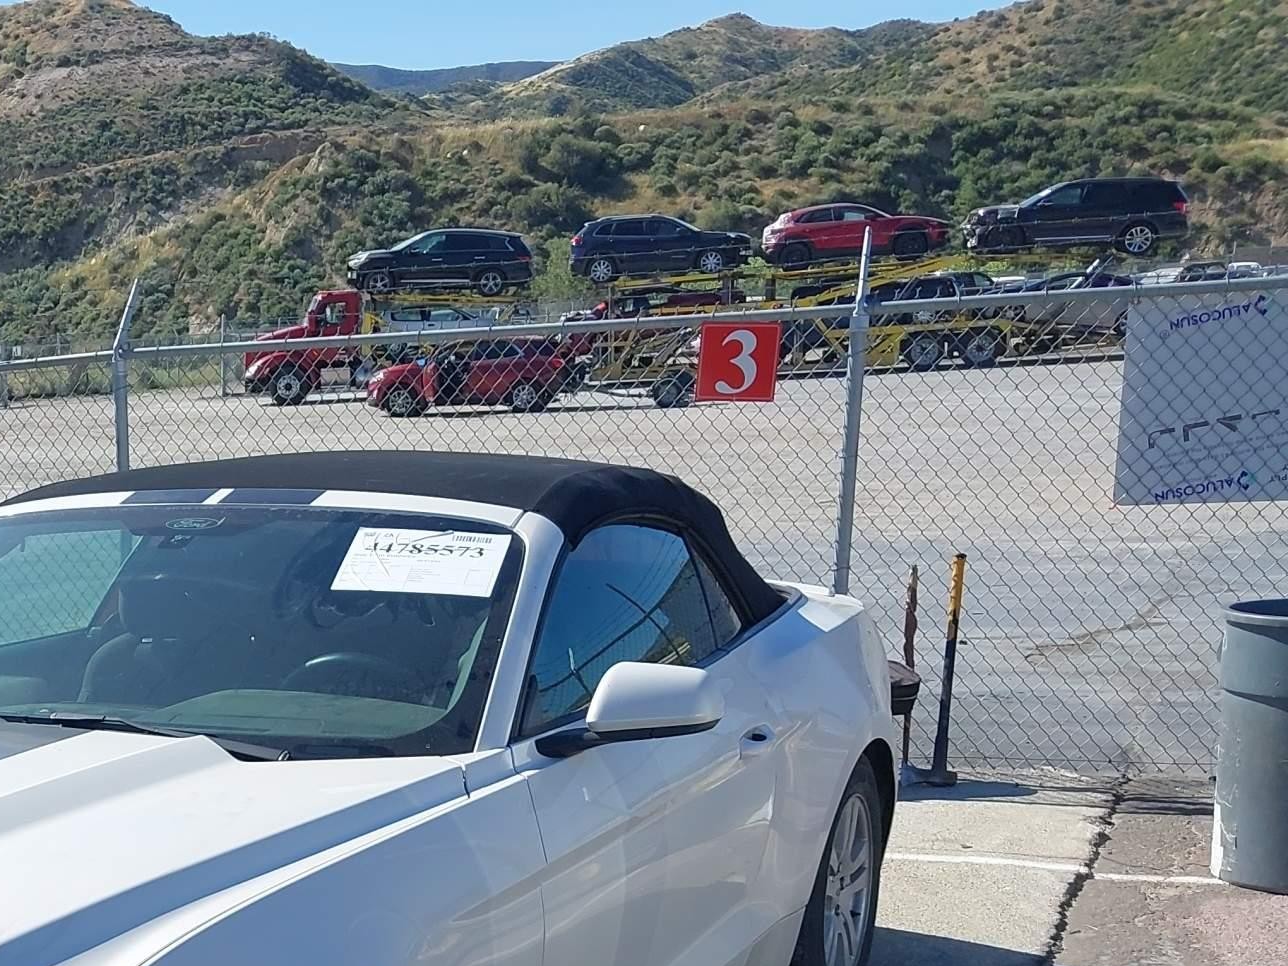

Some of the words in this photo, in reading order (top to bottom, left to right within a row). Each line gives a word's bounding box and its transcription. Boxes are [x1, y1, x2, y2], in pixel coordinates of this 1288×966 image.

[1169, 304, 1252, 330] ALUCOSUN
[715, 329, 757, 394] 3
[1155, 477, 1233, 501] ALUCOSUN
[363, 542, 485, 559] 44785573
